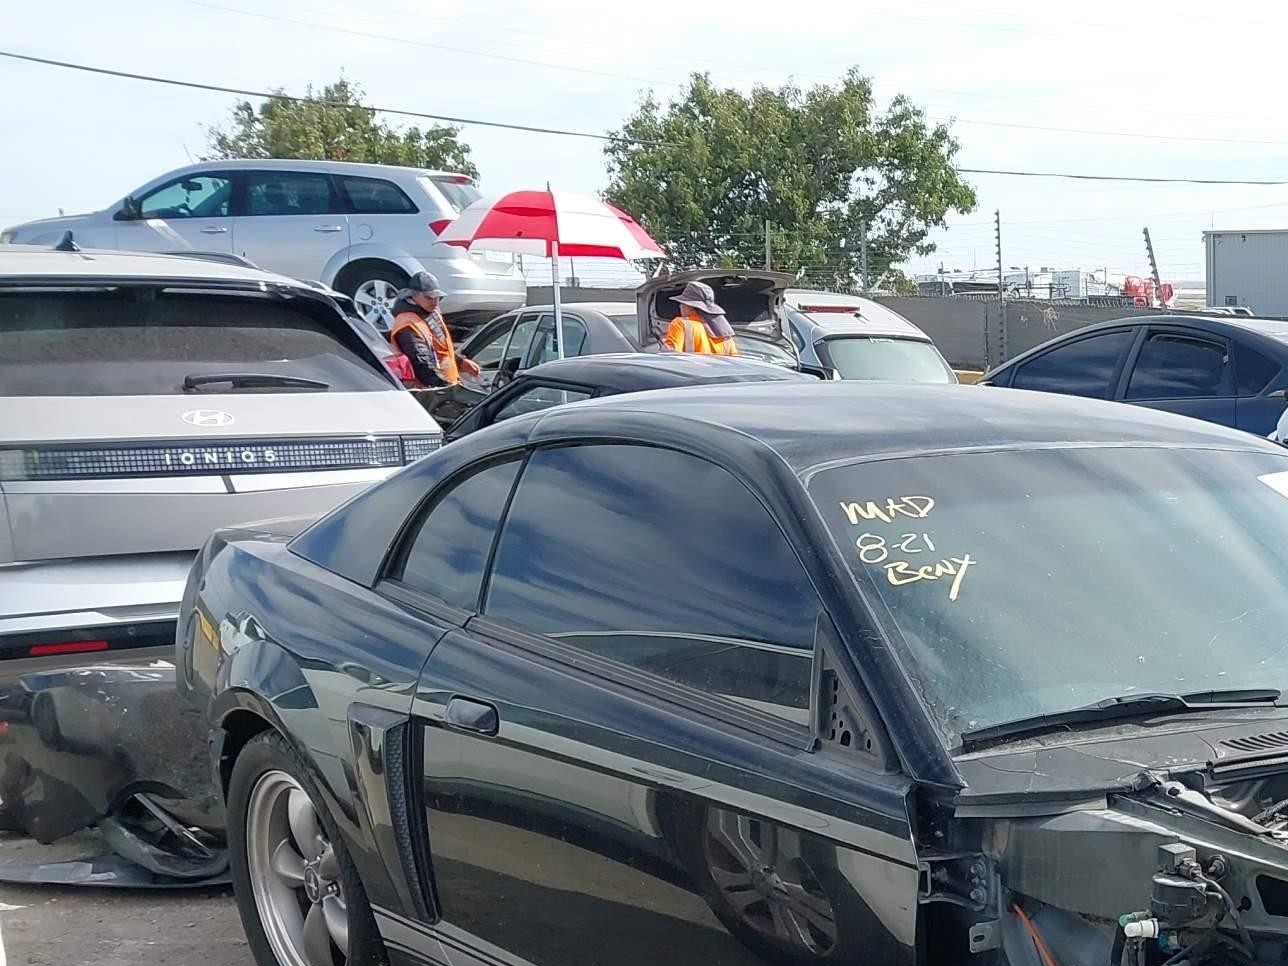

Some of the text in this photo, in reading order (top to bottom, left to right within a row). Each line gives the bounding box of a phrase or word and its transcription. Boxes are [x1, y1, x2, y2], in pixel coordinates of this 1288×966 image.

[165, 450, 276, 465] IONIQ 5
[856, 533, 936, 564] 8-21
